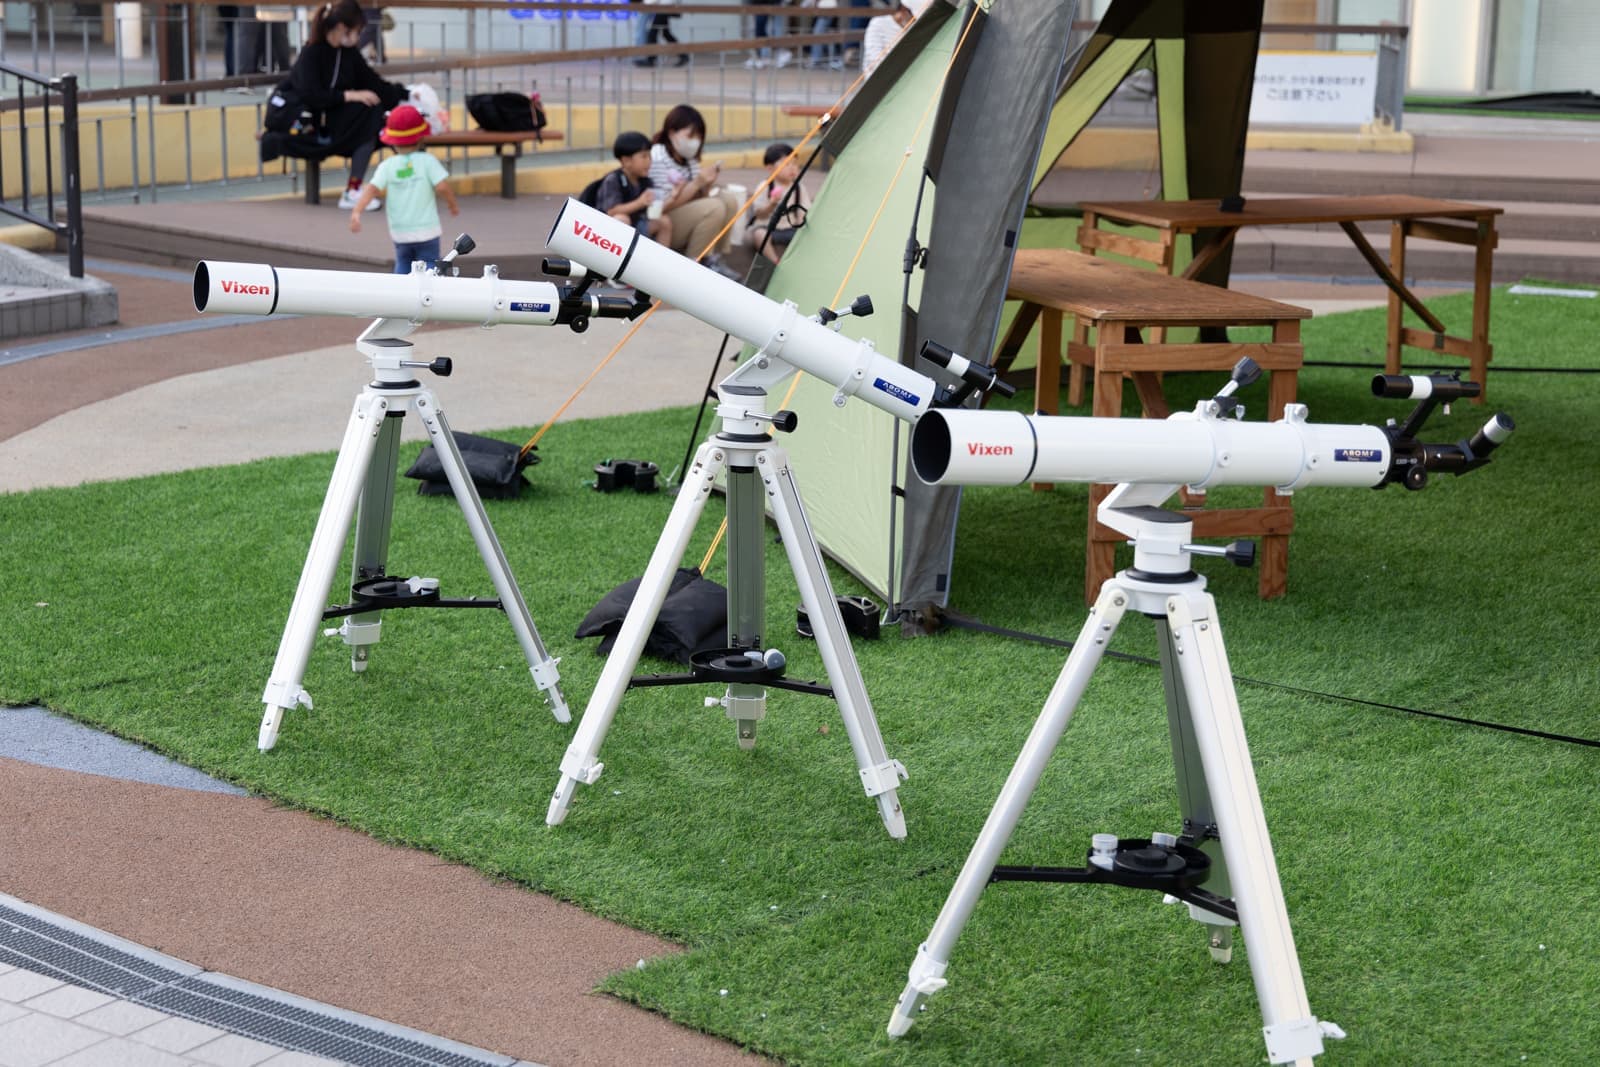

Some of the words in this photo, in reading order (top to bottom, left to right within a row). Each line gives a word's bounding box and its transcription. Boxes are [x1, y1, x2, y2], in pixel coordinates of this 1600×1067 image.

[1266, 88, 1341, 101] ご注意下さい
[574, 219, 623, 256] Vixen
[221, 280, 270, 296] Vixen
[967, 442, 1014, 456] Vixen
